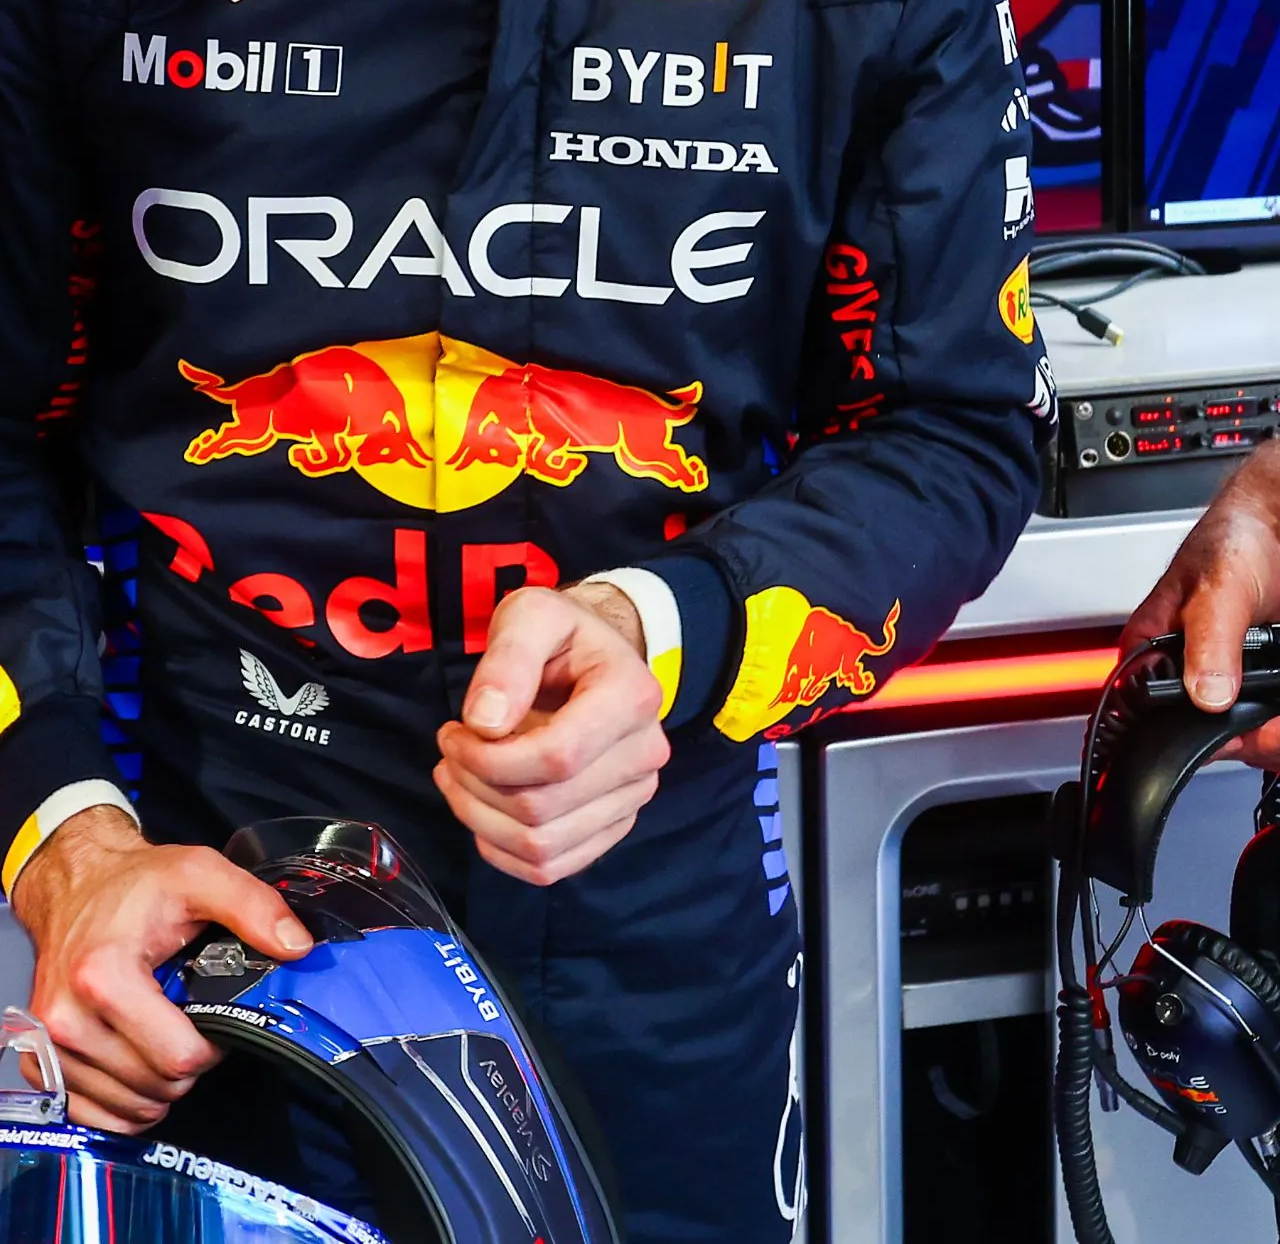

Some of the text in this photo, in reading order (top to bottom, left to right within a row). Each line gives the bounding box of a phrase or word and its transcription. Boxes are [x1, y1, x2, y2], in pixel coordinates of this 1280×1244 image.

[122, 33, 276, 92] Mobil
[571, 43, 772, 109] BYBIT
[549, 132, 779, 173] HONDA
[131, 188, 765, 305] ORACLE
[235, 711, 330, 747] CASTORE
[435, 940, 500, 1023] BYBIT
